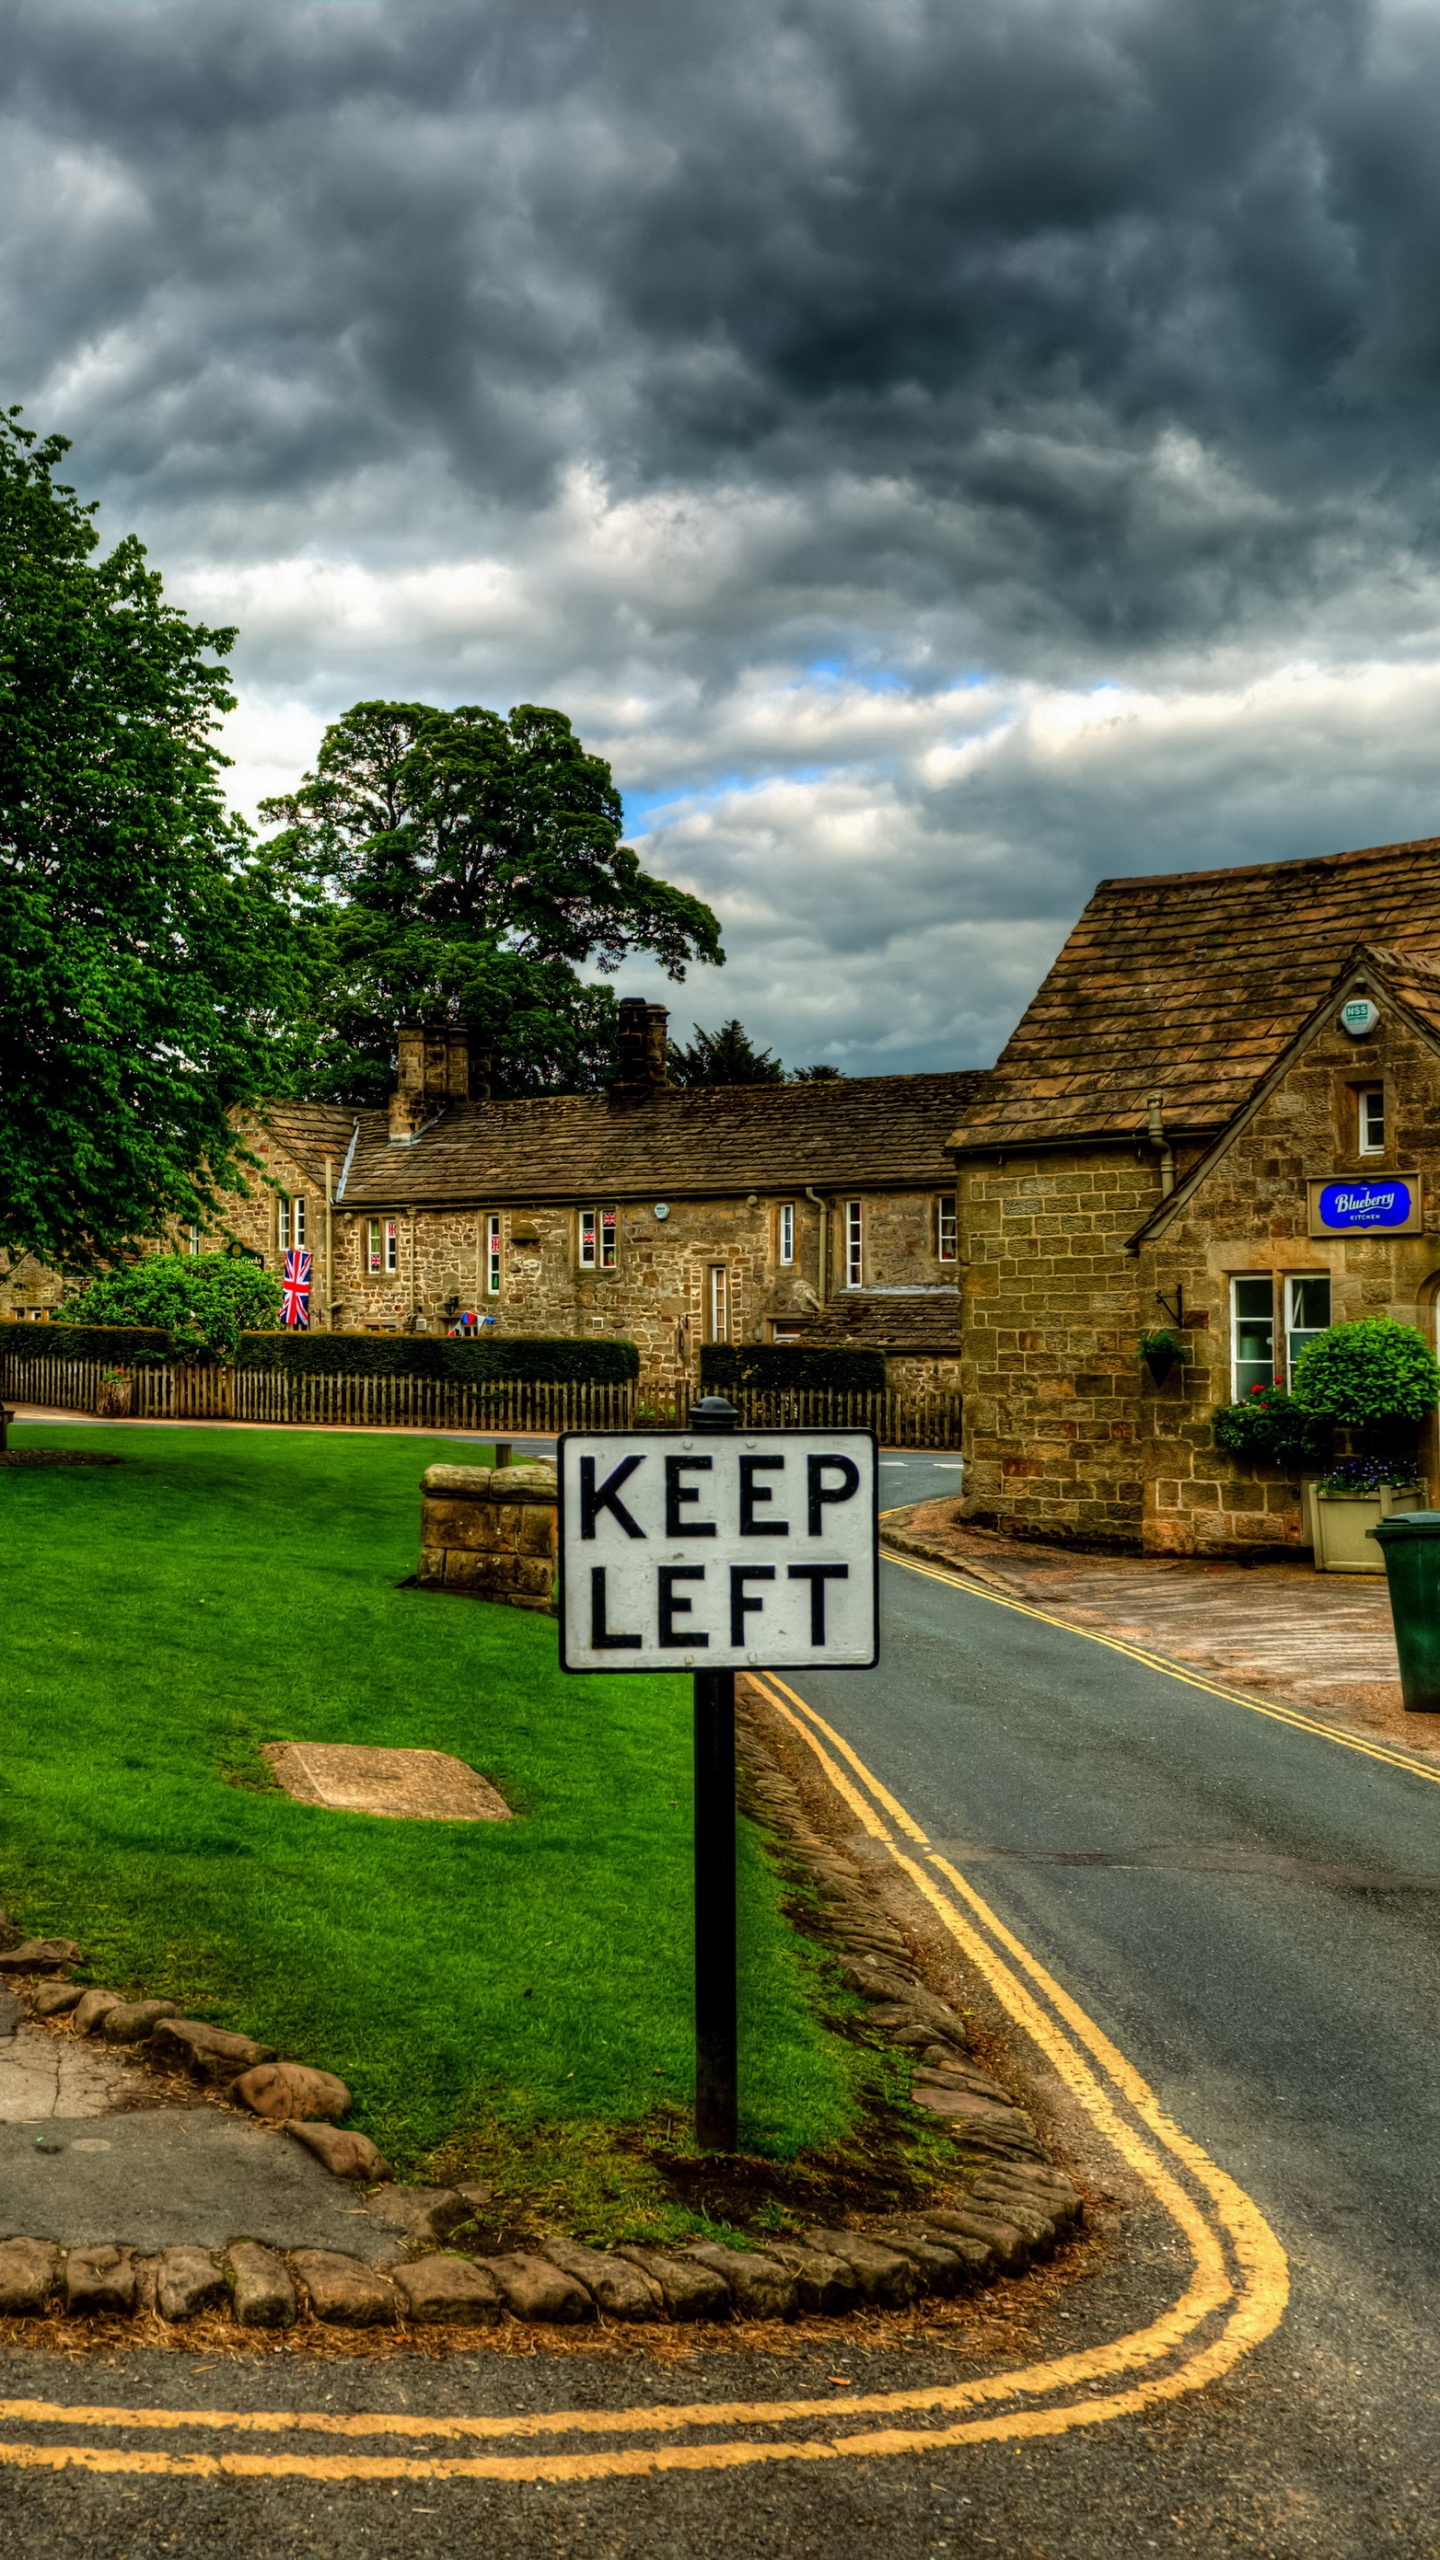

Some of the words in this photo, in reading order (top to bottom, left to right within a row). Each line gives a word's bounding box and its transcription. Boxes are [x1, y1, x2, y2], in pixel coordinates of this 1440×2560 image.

[1347, 1005, 1367, 1016] NSS
[1335, 1191, 1395, 1213] Blueberry
[580, 1454, 860, 1539] KEEP
[591, 1564, 849, 1649] LEFT
